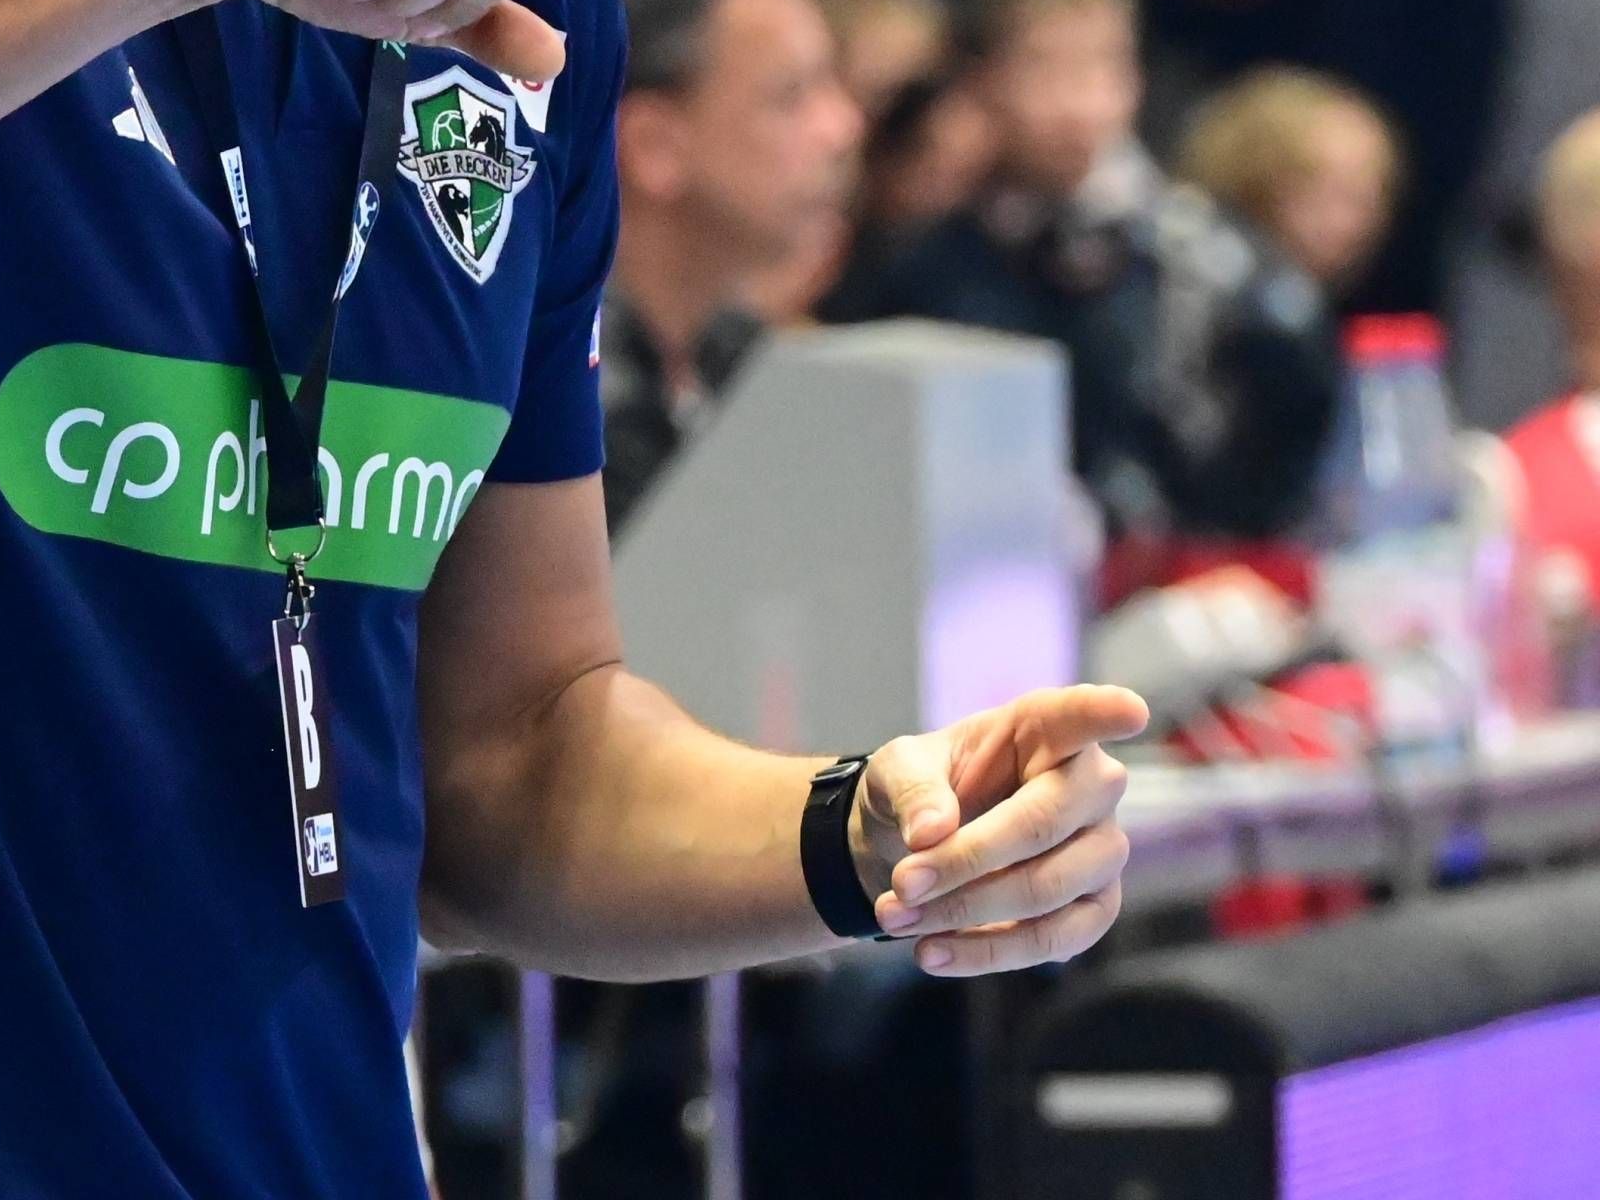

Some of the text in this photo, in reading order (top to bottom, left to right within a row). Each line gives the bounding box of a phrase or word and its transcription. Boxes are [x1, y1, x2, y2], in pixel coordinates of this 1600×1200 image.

[423, 154, 508, 190] DIE RECKEN
[45, 407, 180, 514] cp
[290, 644, 321, 790] B
